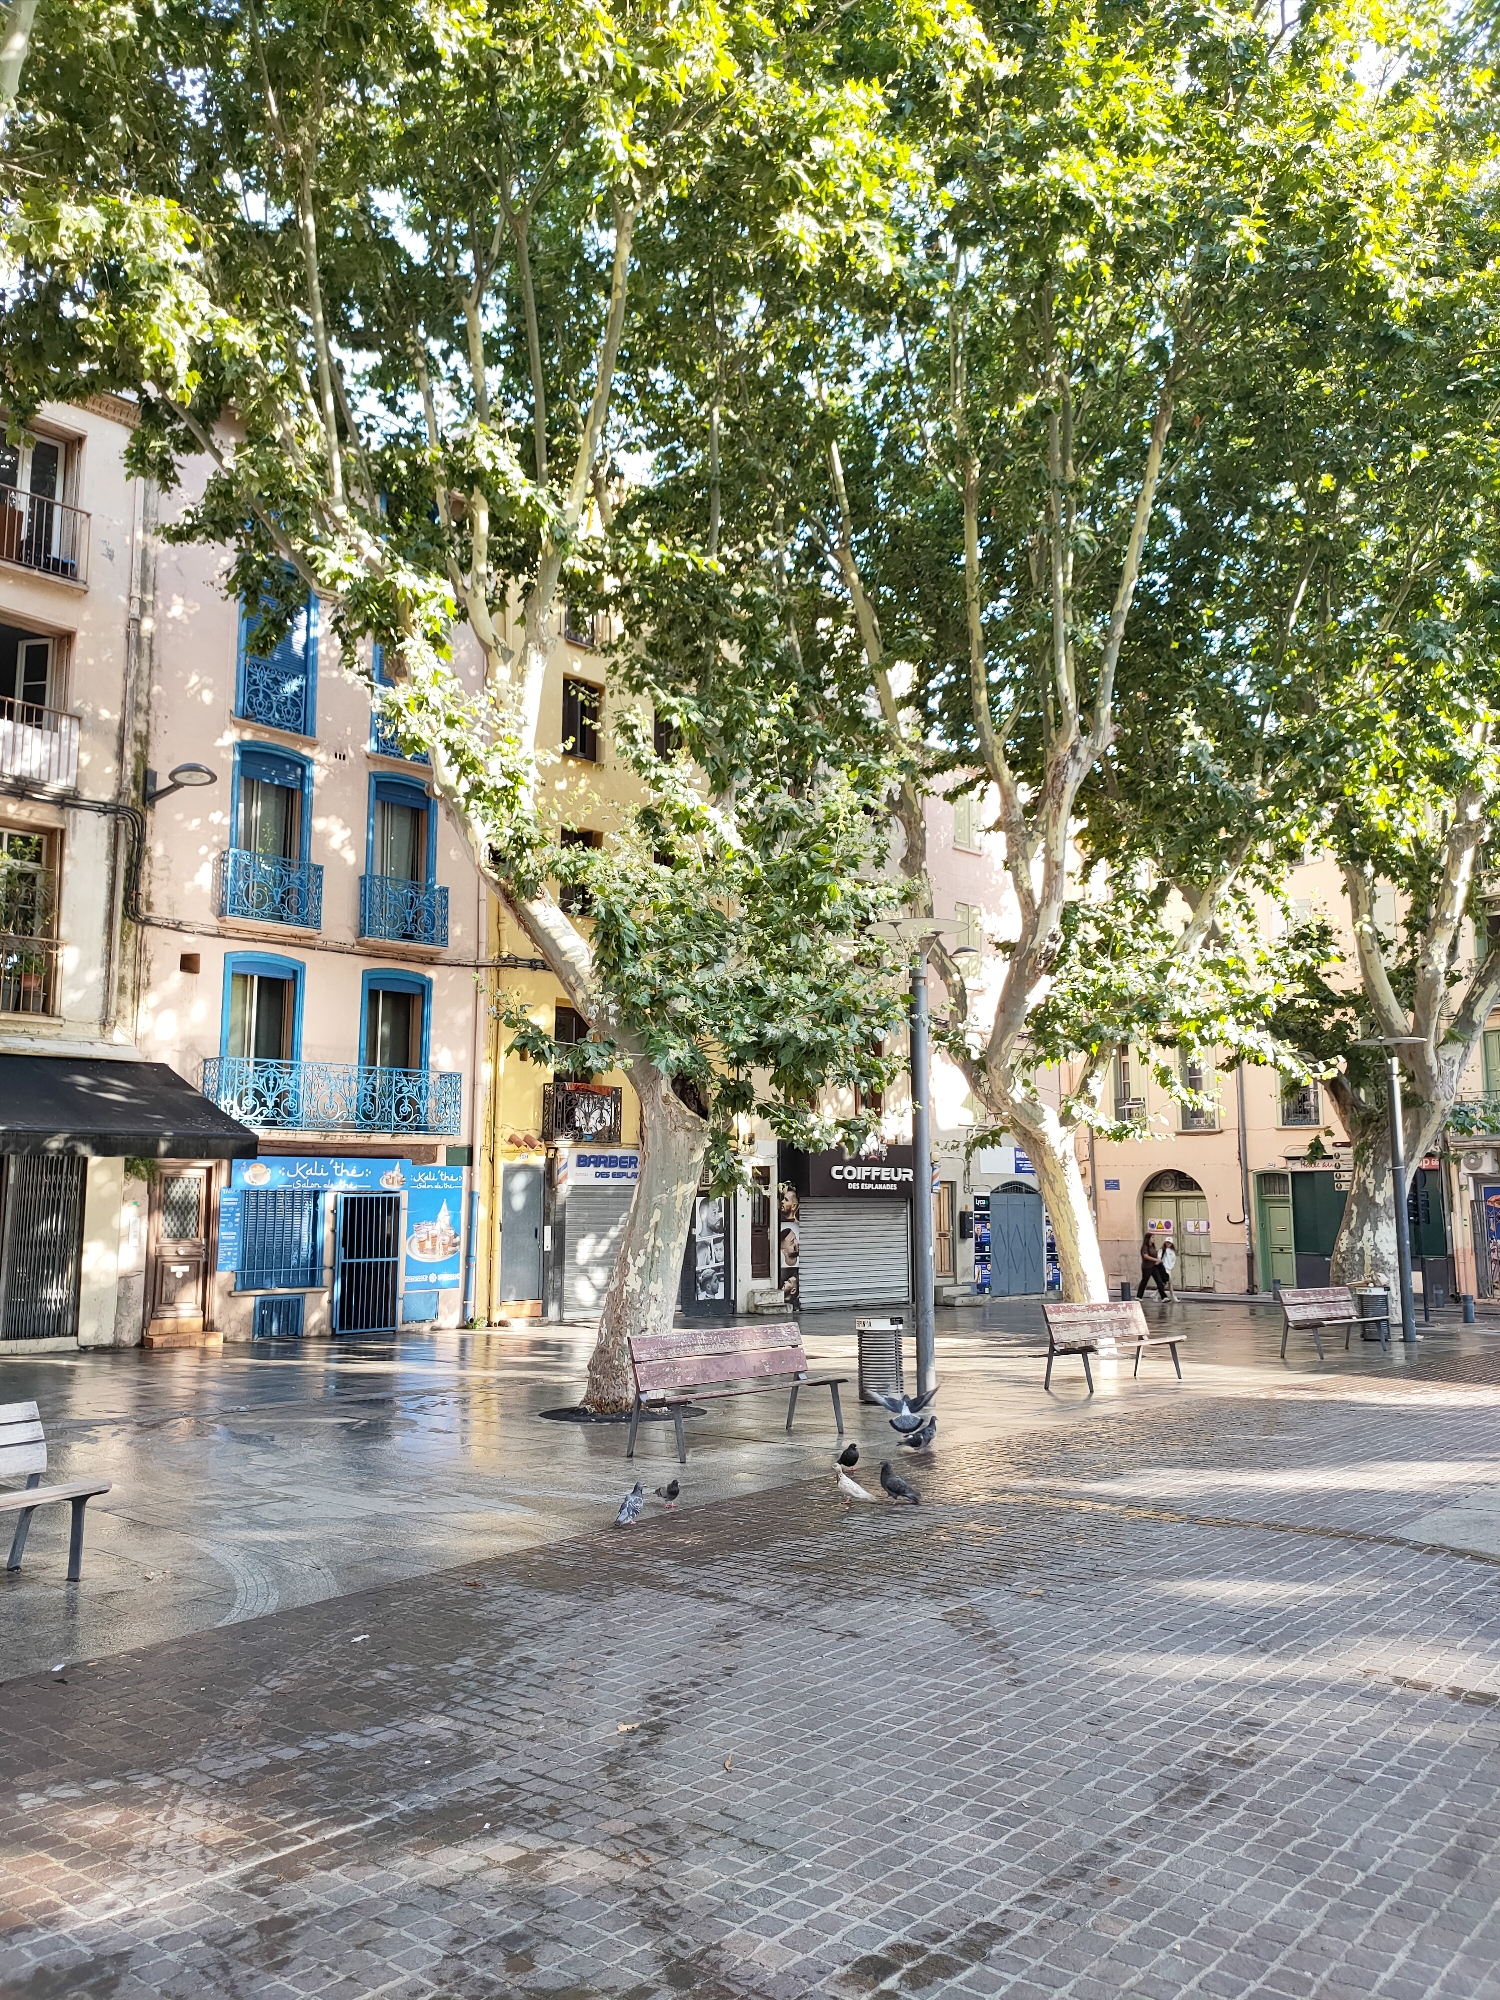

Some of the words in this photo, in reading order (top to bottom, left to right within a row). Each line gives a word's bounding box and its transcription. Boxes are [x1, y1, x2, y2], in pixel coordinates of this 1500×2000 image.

[576, 1154, 638, 1168] BARBER
[595, 1171, 610, 1179] DES
[612, 1171, 639, 1179] ESPLA
[830, 1165, 914, 1182] COIFFEUR
[292, 1179, 322, 1189] Salon
[847, 1182, 860, 1190] DES
[860, 1182, 898, 1191] ESPLANADES
